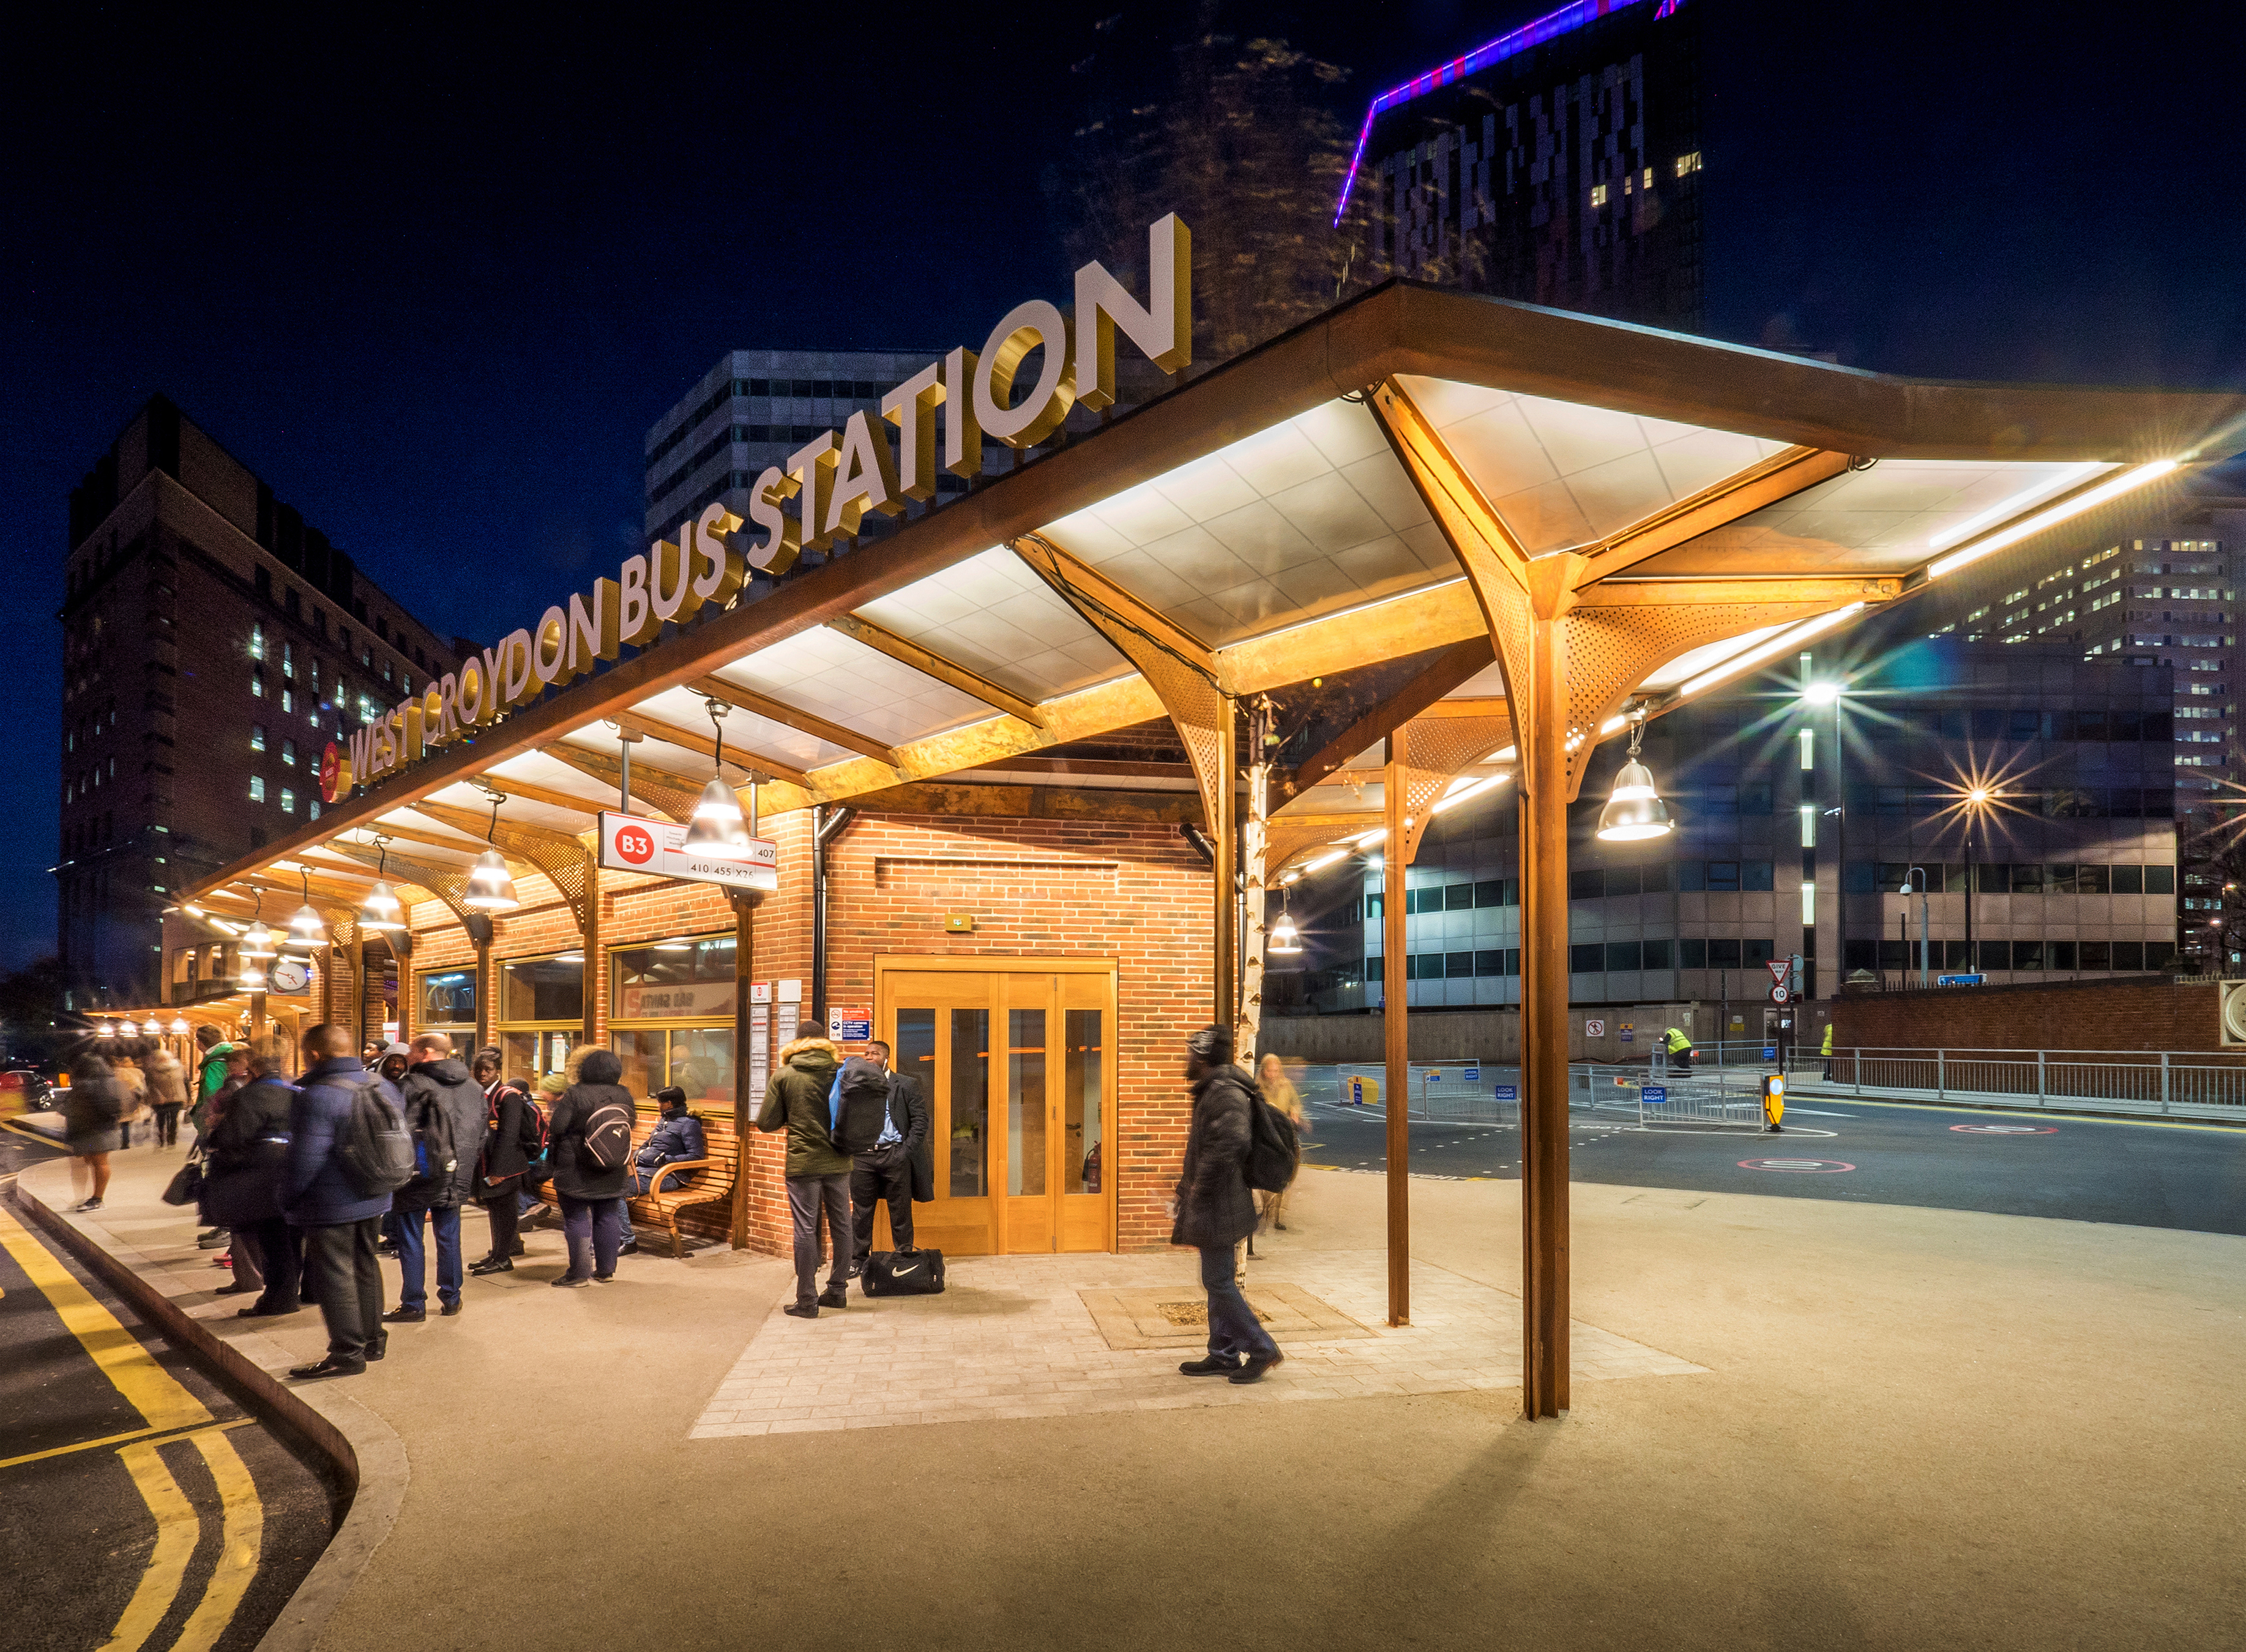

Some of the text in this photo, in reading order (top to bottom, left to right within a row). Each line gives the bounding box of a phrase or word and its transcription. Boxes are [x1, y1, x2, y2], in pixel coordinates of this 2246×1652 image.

[349, 210, 1186, 784] WEST CROYDON BUS STATION
[622, 835, 647, 855] B3
[758, 849, 774, 858] 407
[690, 863, 709, 873] 410
[714, 867, 731, 876] 455
[736, 869, 754, 879] X26
